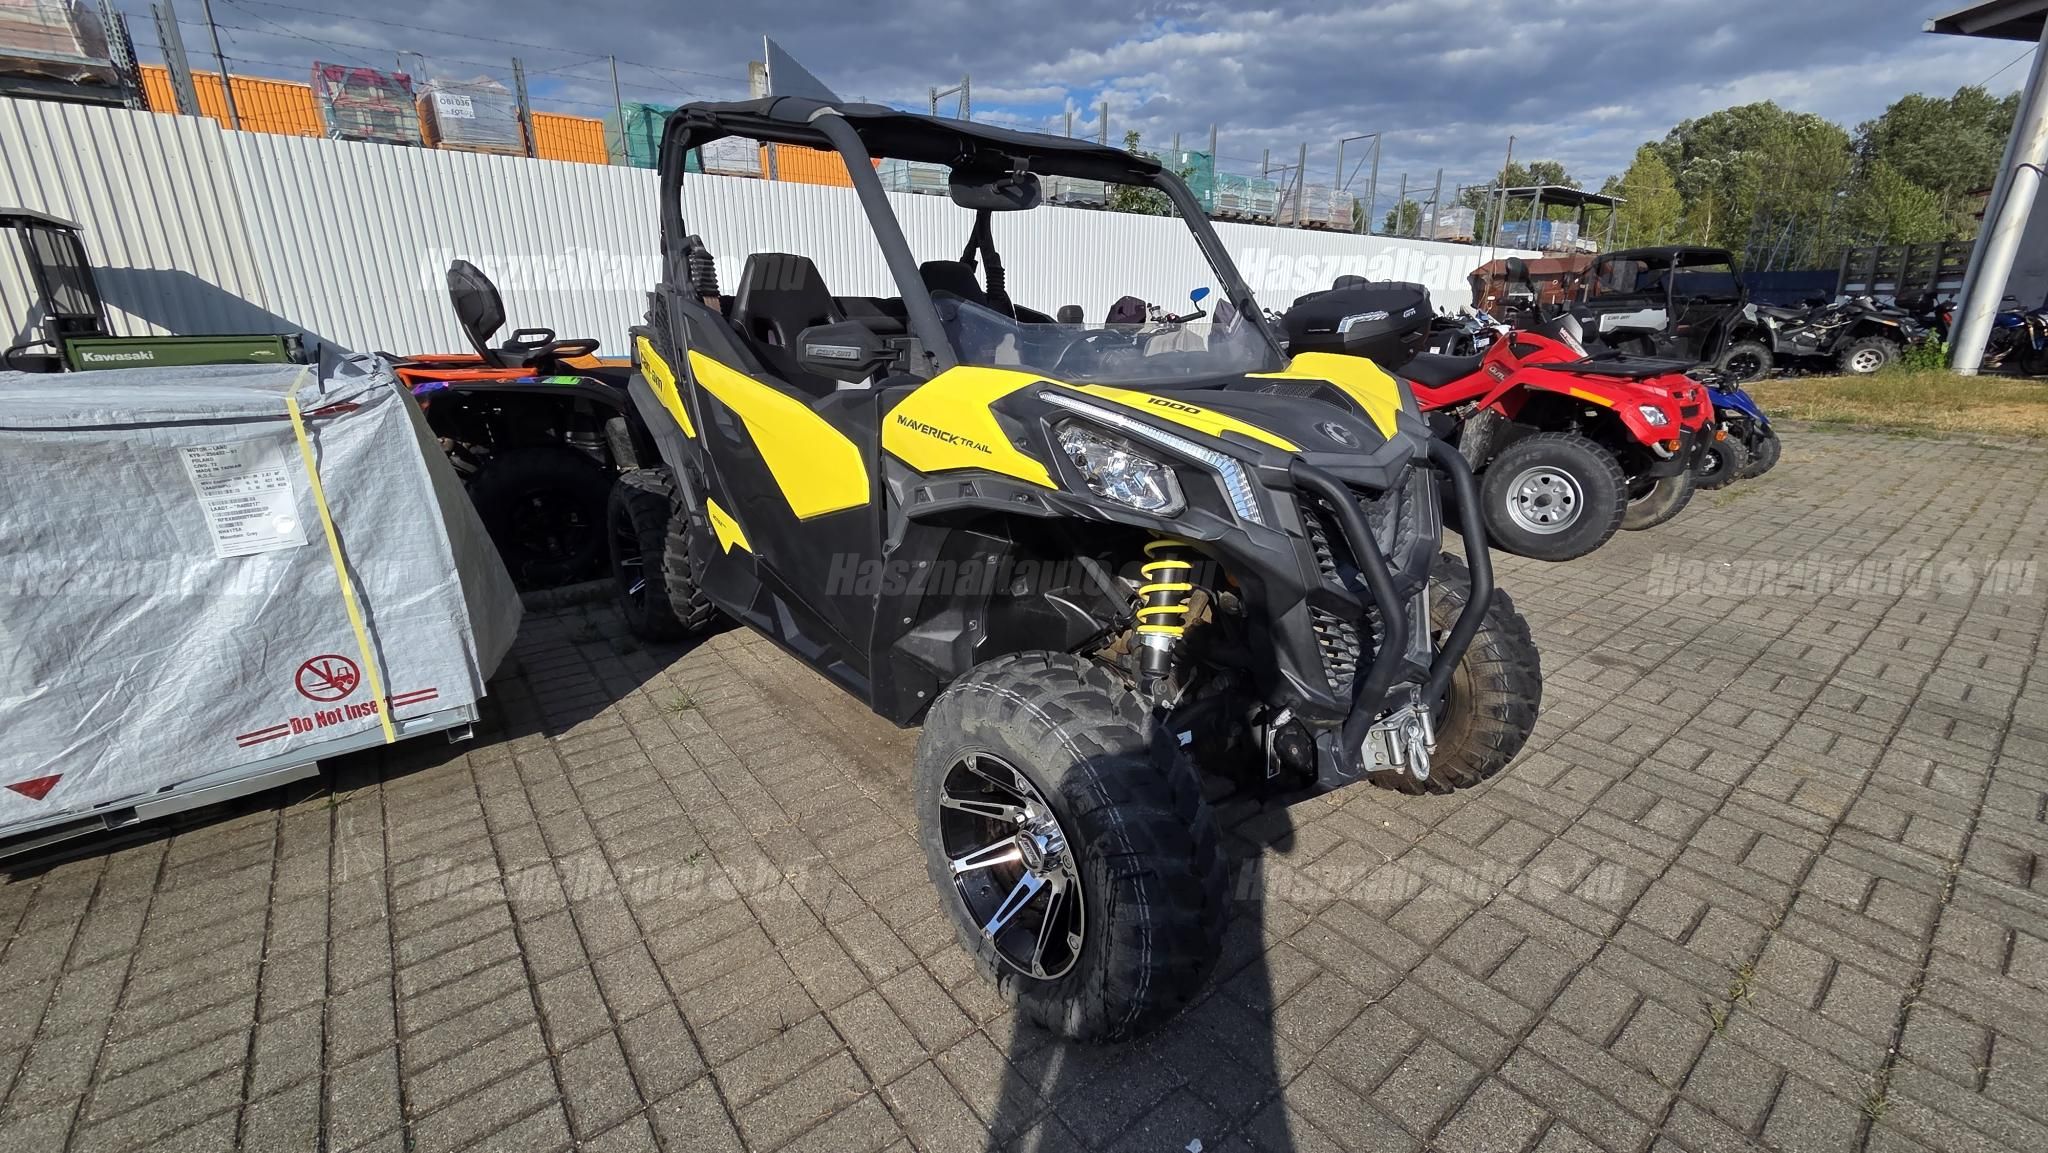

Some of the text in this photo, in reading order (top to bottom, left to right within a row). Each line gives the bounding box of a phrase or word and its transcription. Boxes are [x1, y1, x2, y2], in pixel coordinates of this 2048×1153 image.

[82, 350, 154, 362] Kawasaki
[1147, 397, 1201, 414] 1000
[896, 414, 993, 454] MAVERICK TRAIL
[289, 716, 314, 735] Do
[314, 707, 344, 726] Not
